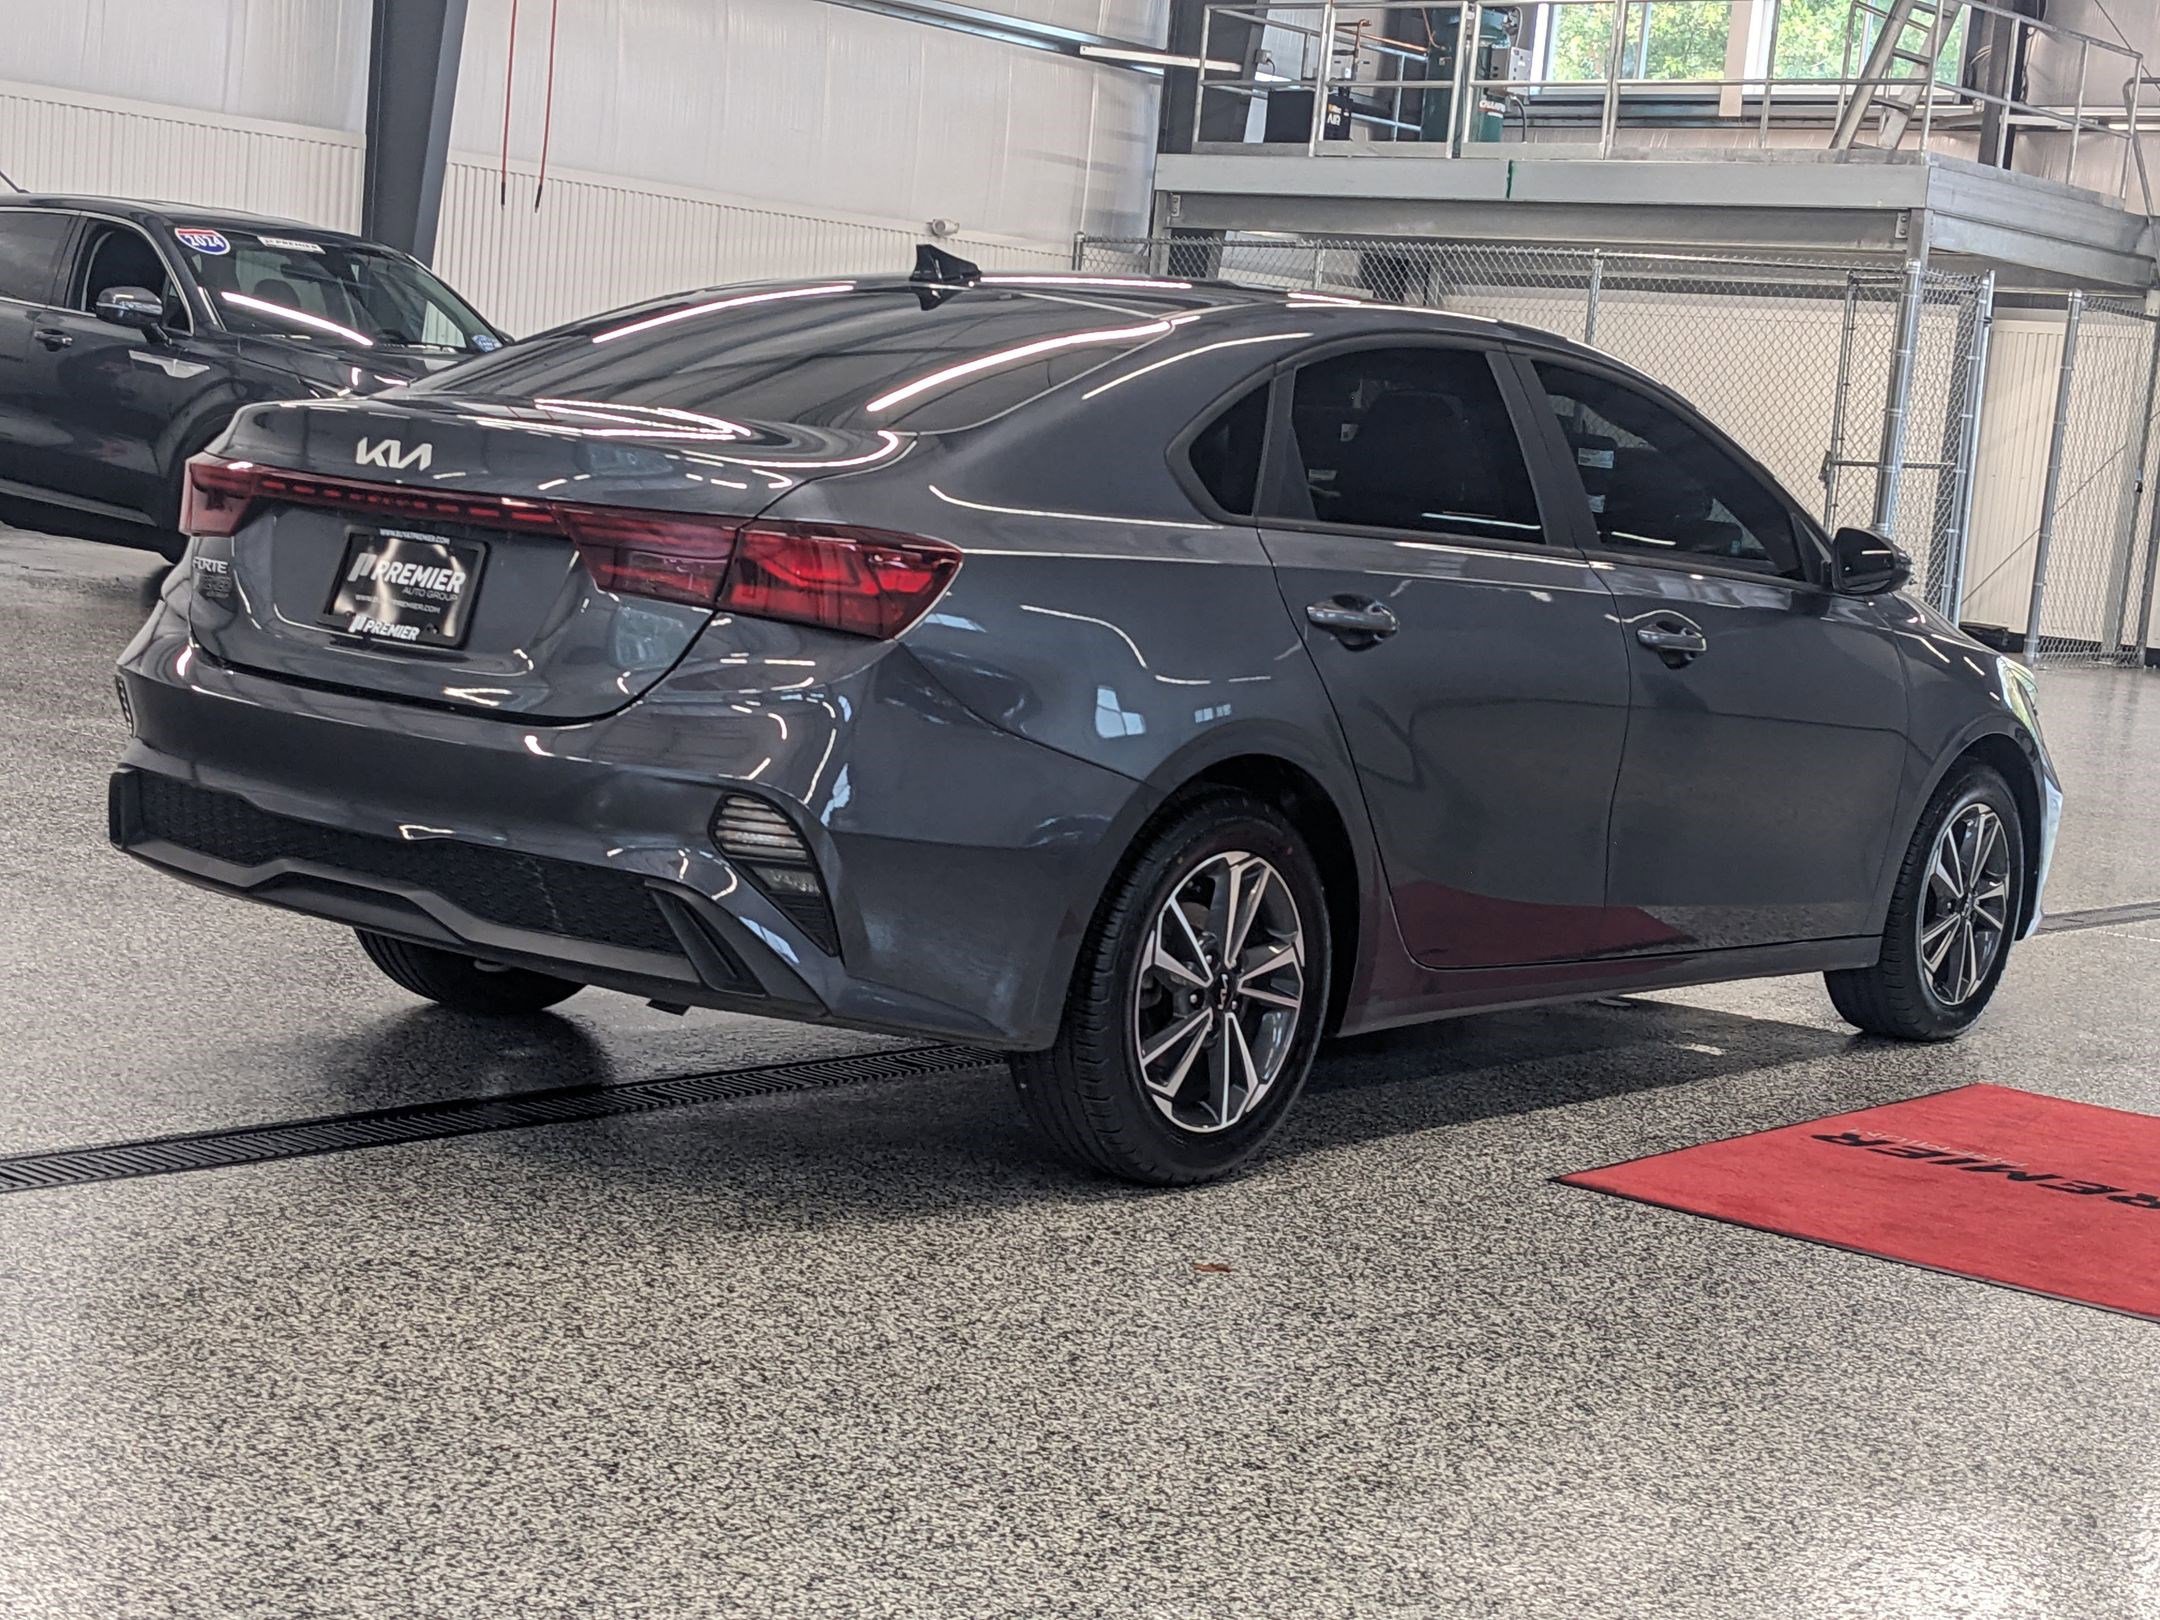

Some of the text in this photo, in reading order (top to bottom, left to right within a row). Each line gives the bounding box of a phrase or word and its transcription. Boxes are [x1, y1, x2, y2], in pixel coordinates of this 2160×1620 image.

[184, 234, 224, 248] 2024
[356, 437, 432, 471] KIA
[193, 556, 228, 574] FORTE
[370, 561, 466, 594] PREMIER
[402, 586, 458, 601] AUTO GROUP
[362, 619, 421, 641] PREMIER
